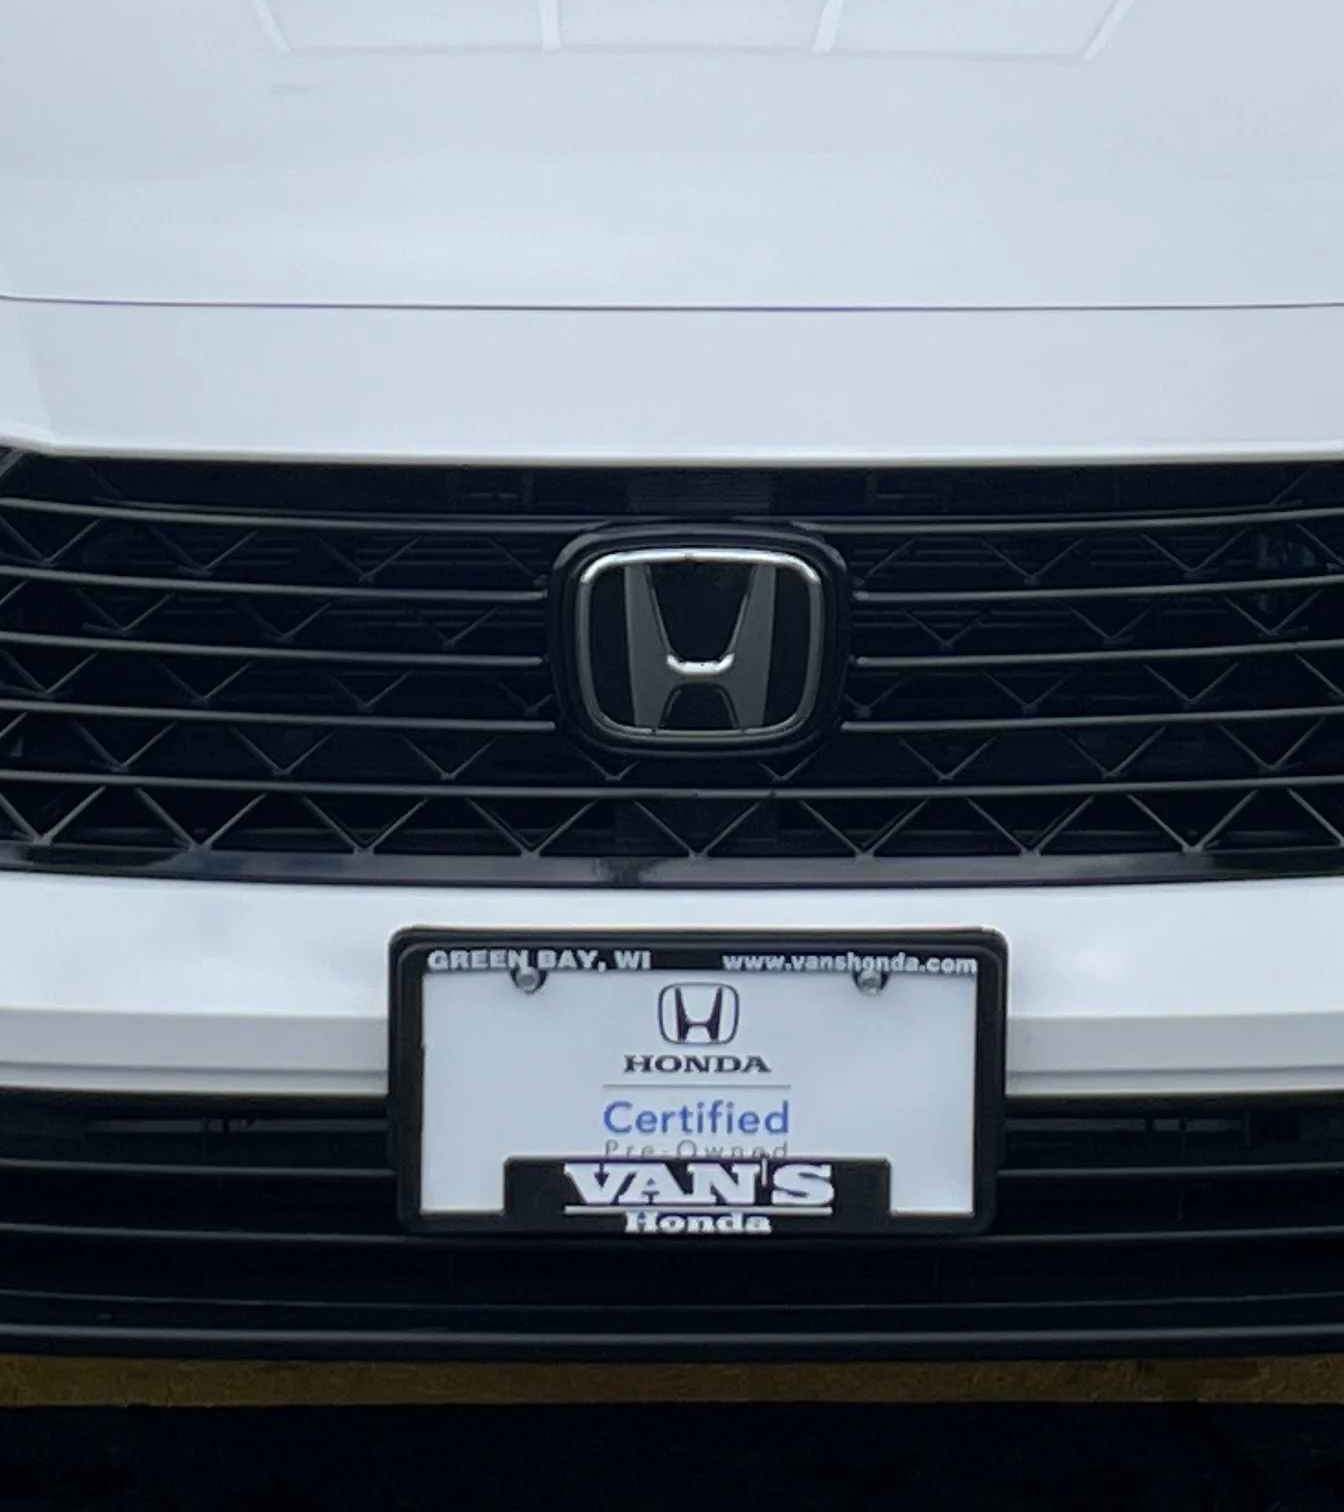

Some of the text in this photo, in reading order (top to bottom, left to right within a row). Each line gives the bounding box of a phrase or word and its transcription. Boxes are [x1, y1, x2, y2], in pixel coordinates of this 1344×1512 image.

[427, 949, 651, 972] GREEN BAY, WI
[722, 951, 978, 974] www.vanshonda.com
[623, 1054, 772, 1074] HONDA
[603, 1099, 790, 1134] Certified
[563, 1158, 835, 1205] VAN'S
[624, 1210, 773, 1234] Honda
